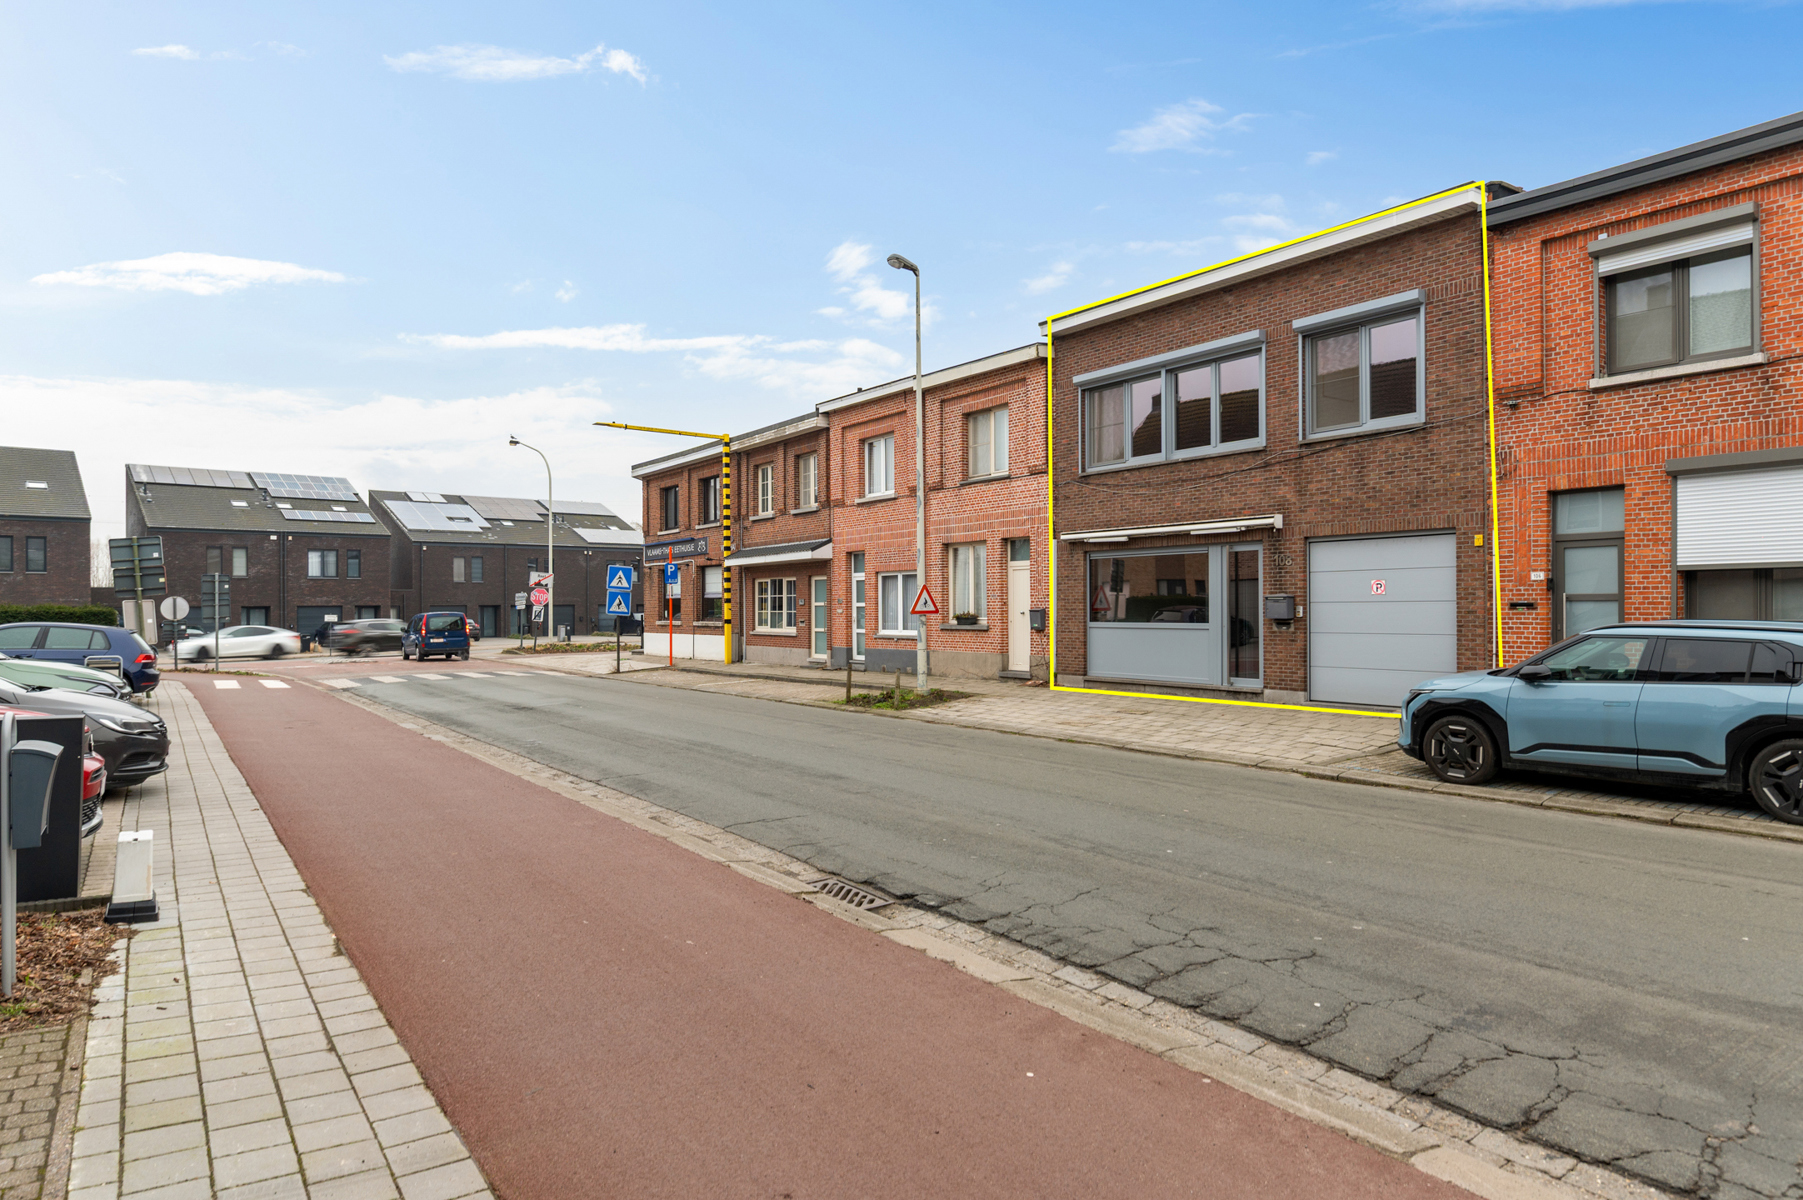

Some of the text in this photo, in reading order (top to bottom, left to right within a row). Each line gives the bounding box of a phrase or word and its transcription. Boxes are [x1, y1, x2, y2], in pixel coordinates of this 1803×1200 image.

[647, 546, 673, 556] VLAAMS-THAS
[1273, 555, 1292, 566] 108
[667, 564, 675, 576] P
[1375, 583, 1382, 592] P
